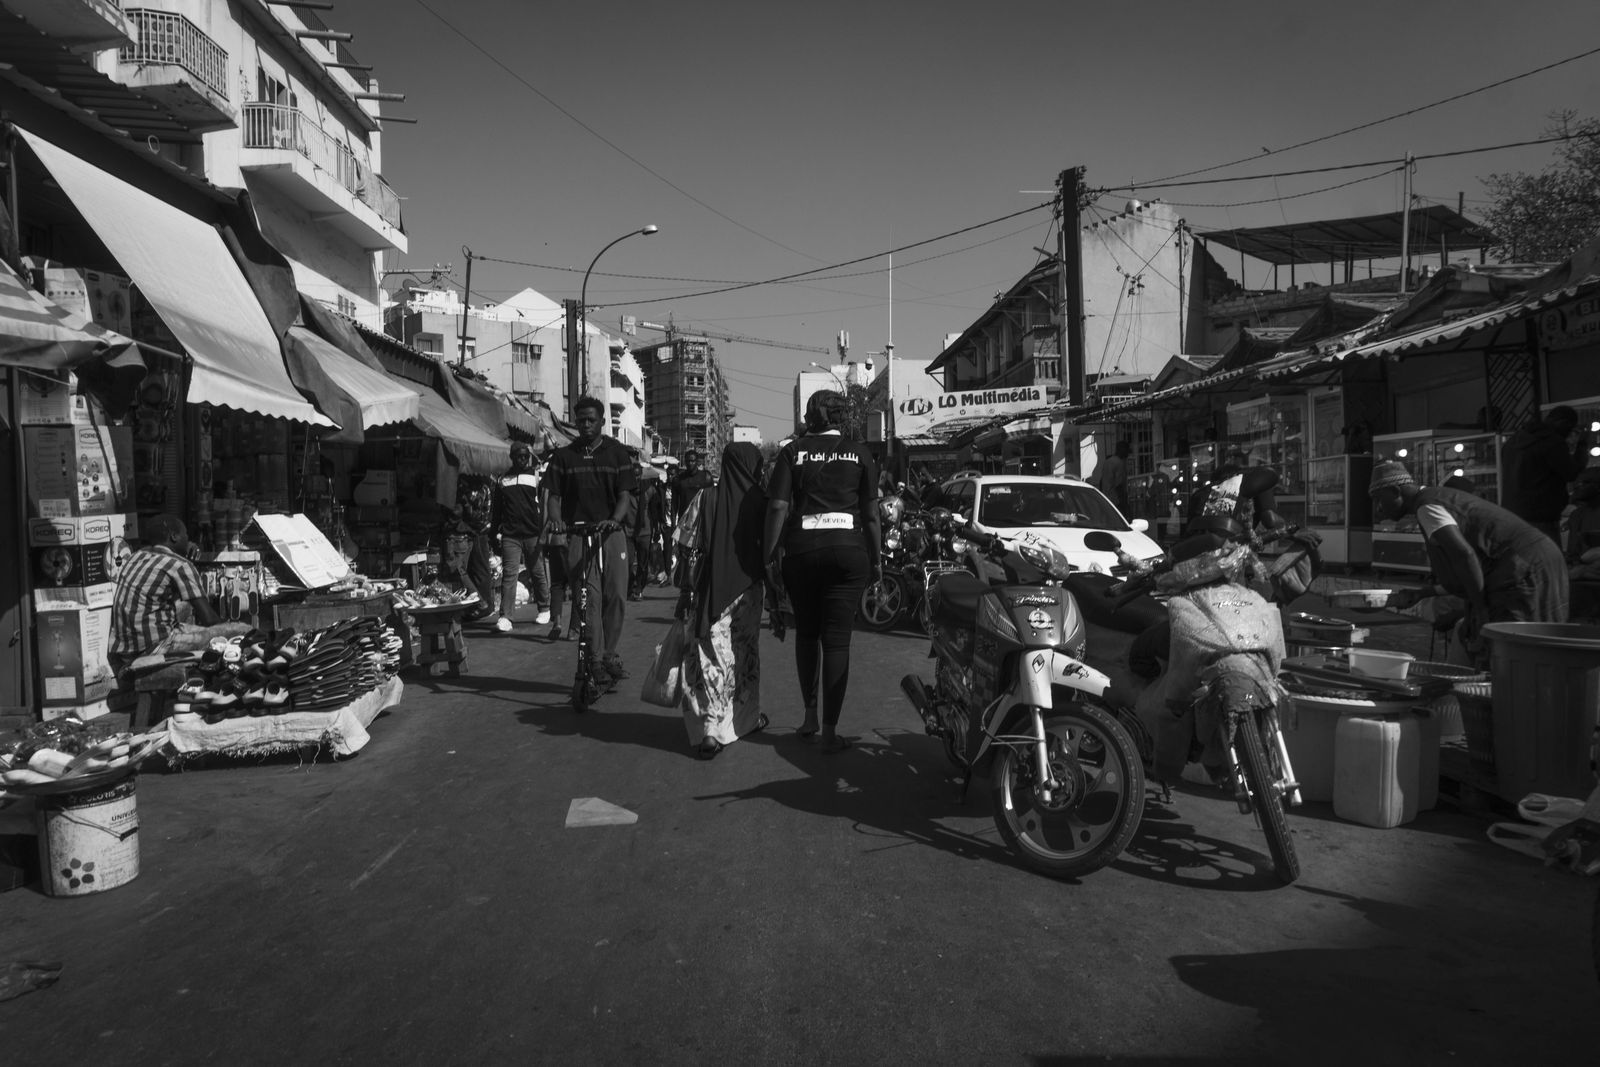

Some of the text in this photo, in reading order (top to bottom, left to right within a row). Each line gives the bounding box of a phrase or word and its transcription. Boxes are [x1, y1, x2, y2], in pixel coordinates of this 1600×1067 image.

[938, 386, 1040, 409] LO Multimédia
[35, 527, 72, 537] KOREQ
[86, 525, 109, 534] KOREQ
